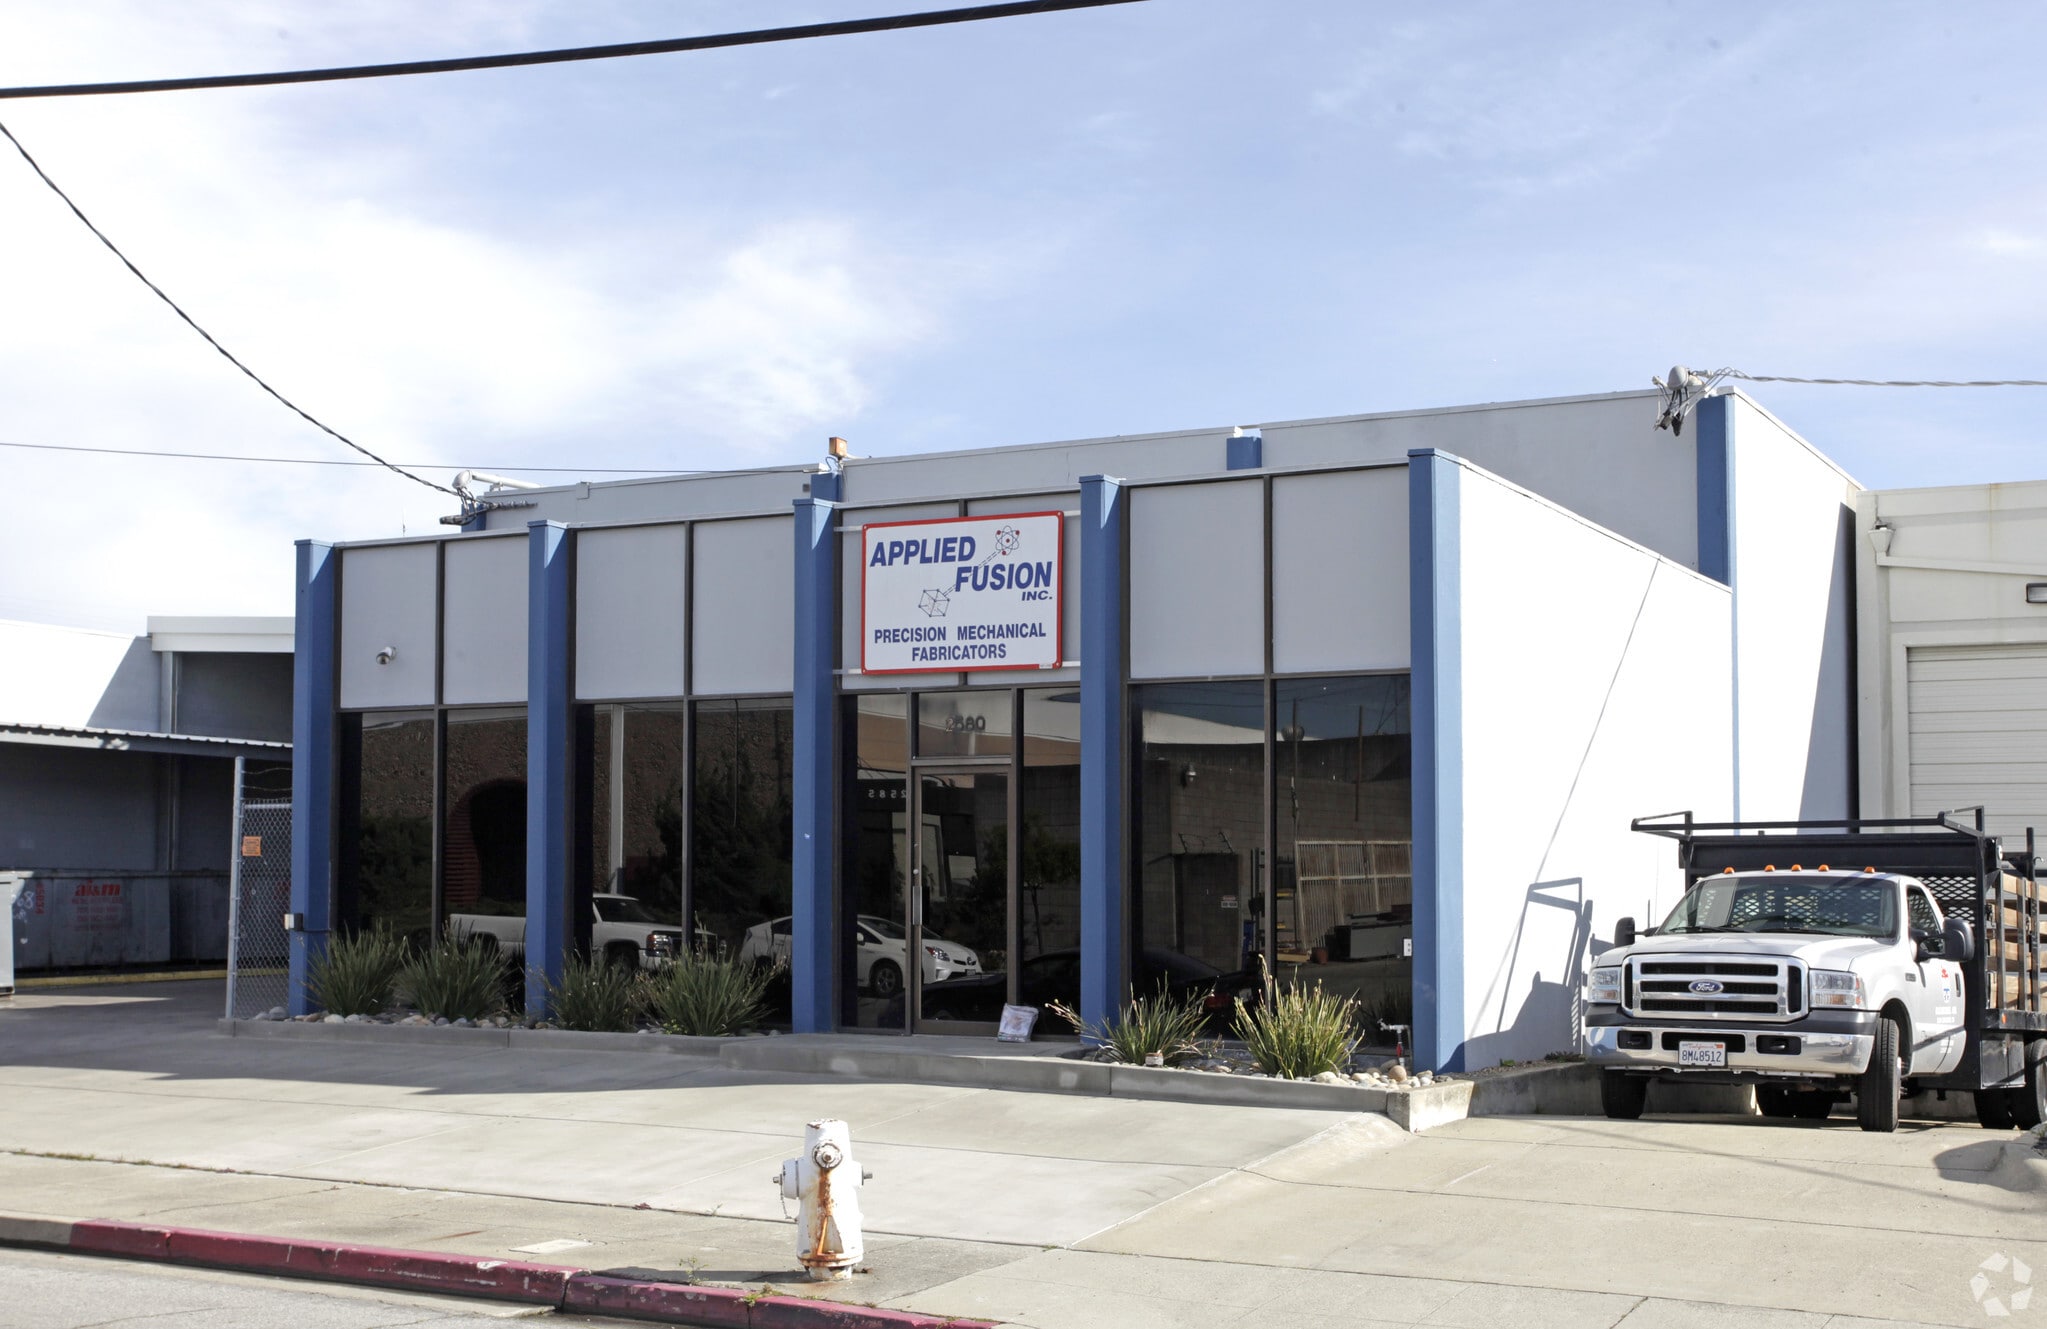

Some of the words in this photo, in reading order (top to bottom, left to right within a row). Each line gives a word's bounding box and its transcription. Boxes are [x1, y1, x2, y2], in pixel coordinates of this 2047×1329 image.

[870, 536, 976, 567] APPLIED
[955, 561, 1052, 592] FUSION
[1021, 590, 1054, 602] INC.
[874, 627, 946, 643] PRECISION
[957, 622, 1047, 641] MECHANICAL
[912, 643, 1006, 661] FABRICATORS
[1695, 982, 1716, 992] Ford
[1681, 1050, 1722, 1063] 8M48512
